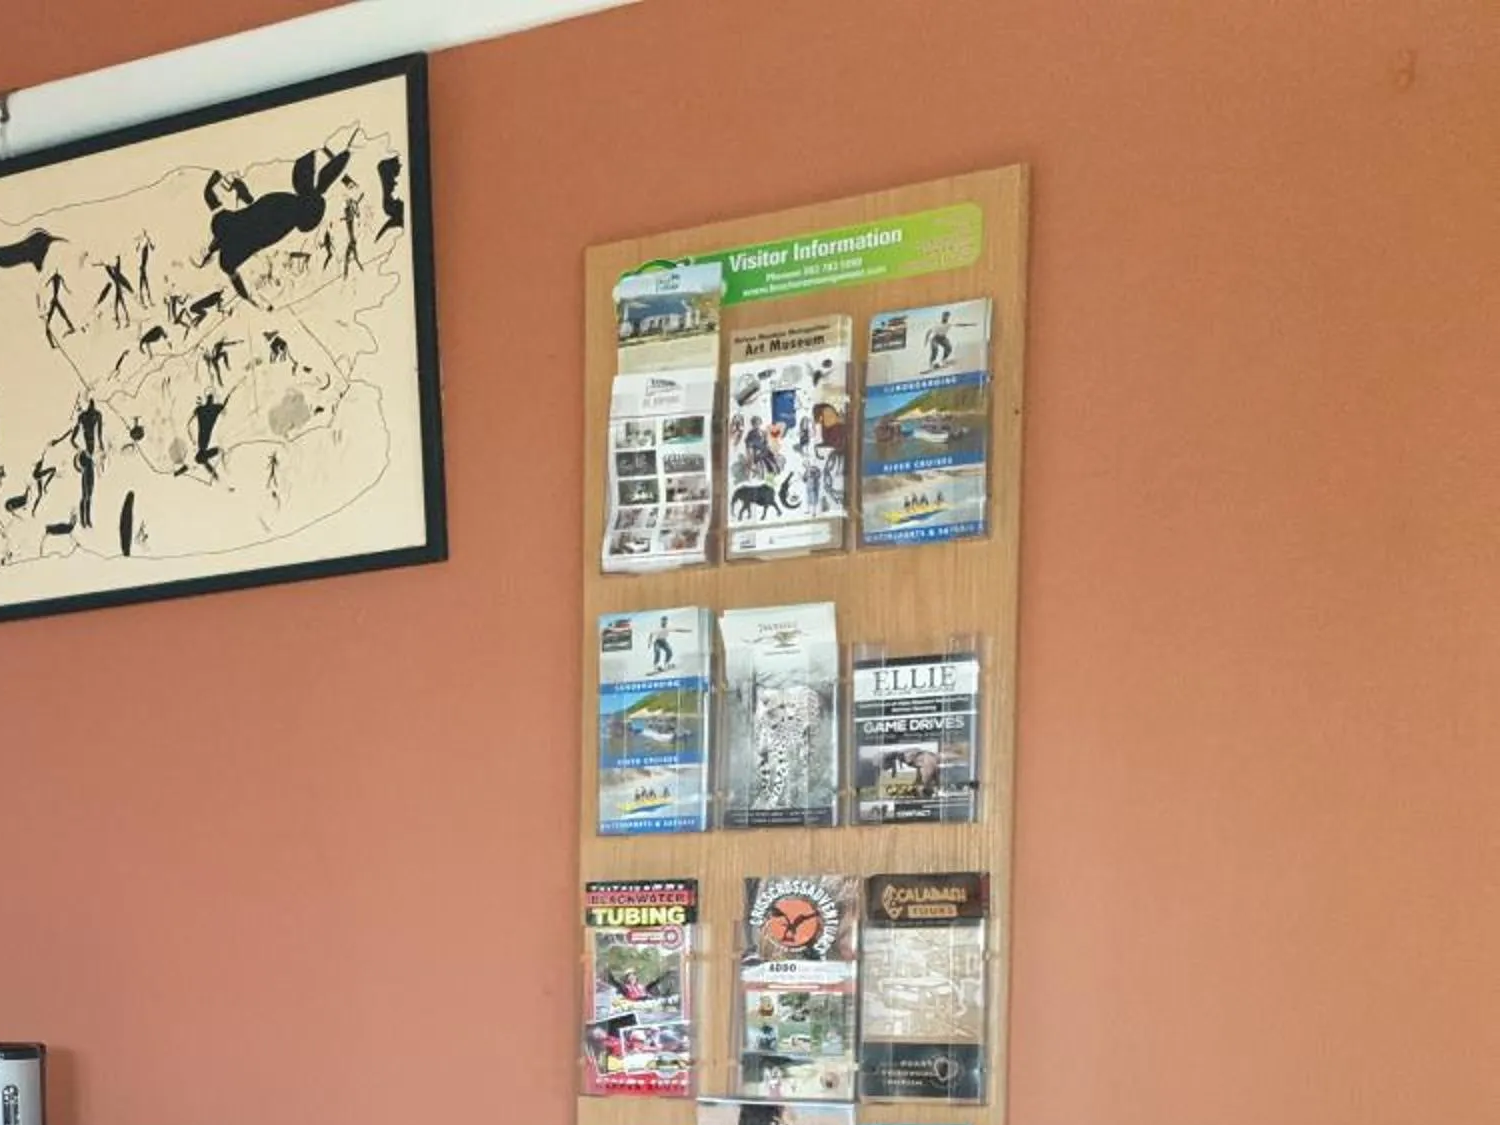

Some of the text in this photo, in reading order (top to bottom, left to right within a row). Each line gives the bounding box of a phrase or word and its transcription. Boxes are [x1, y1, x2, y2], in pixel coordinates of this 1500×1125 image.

[729, 249, 789, 272] Visitor
[793, 228, 903, 261] Information
[745, 335, 825, 356] Art Museum
[873, 665, 957, 691] ELLIE
[863, 715, 965, 733] GAME DRIVES
[591, 906, 685, 925] TUBING
